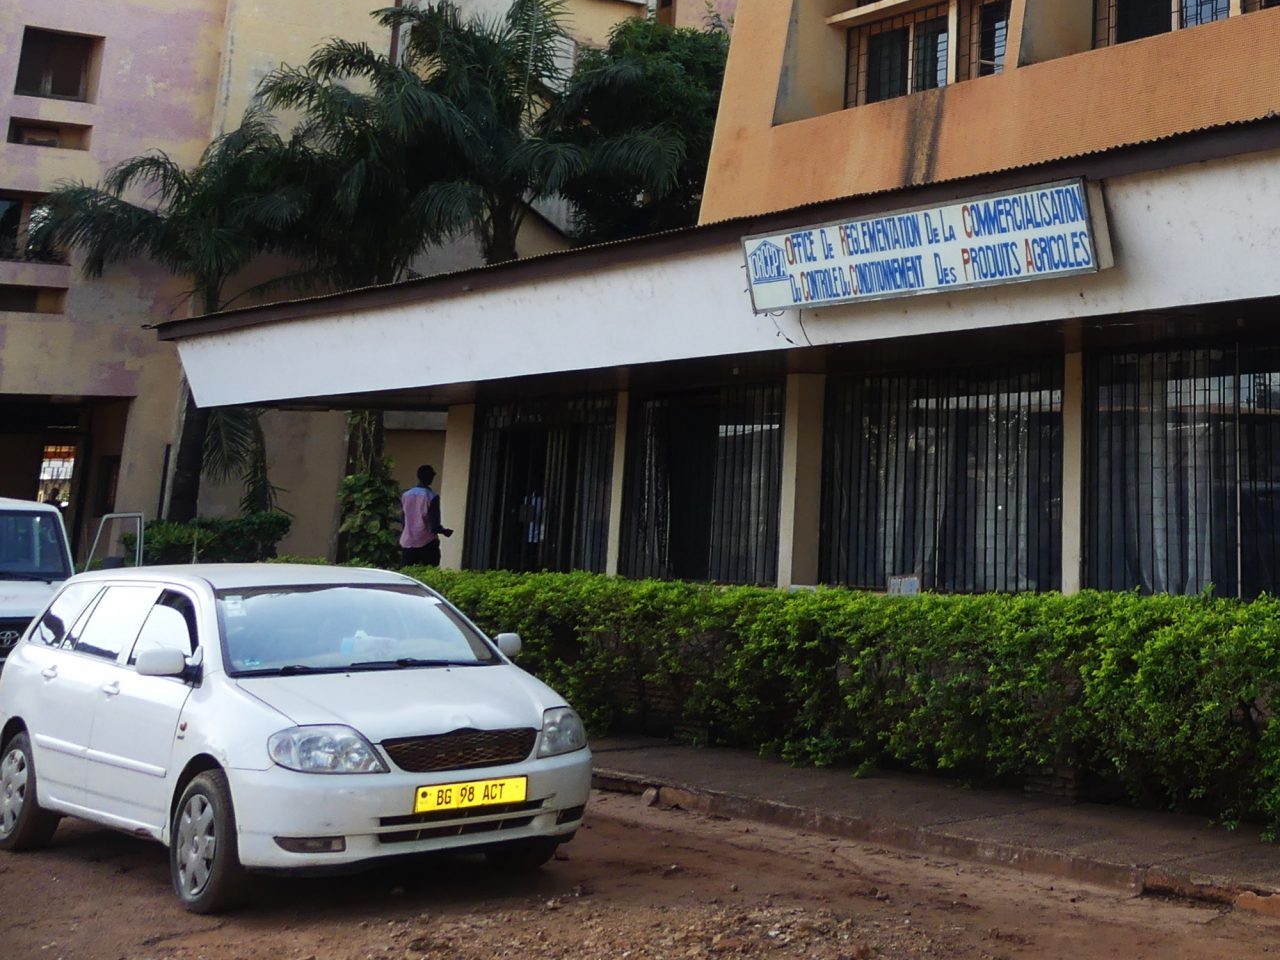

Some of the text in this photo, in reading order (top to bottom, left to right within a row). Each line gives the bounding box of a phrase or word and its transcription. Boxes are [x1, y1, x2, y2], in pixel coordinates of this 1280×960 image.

[785, 230, 817, 265] OFFICE
[838, 214, 922, 257] REGLEMENTATION
[961, 185, 1085, 239] COMMERCIALISATION
[800, 267, 840, 301] CONTROLE
[849, 255, 925, 295] CONDITIONNEMENT
[961, 241, 1022, 281] PRODUITS
[1024, 230, 1091, 273] AGRICOLES
[436, 783, 506, 806] BG 98 ACT
